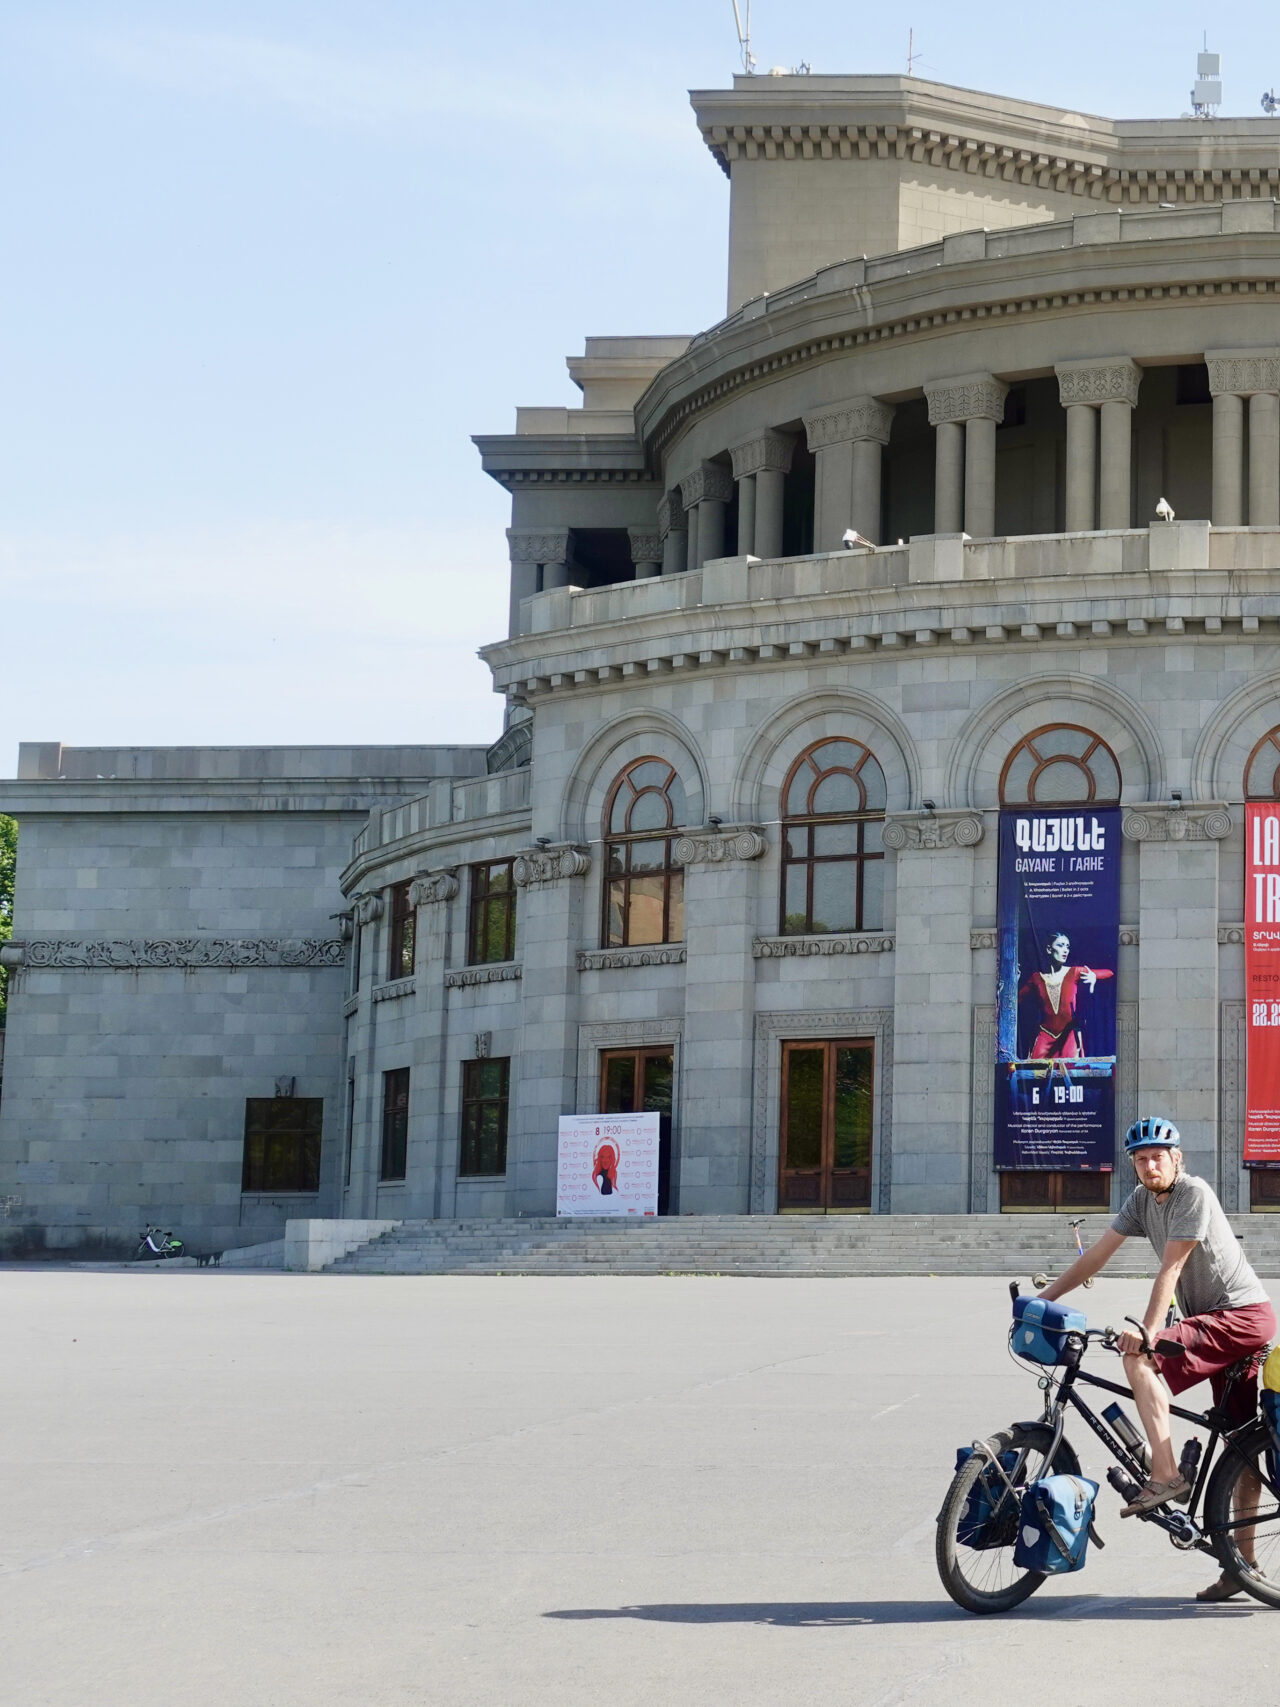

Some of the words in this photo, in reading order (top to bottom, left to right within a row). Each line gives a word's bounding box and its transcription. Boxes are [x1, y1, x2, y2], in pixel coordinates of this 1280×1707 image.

[1016, 817, 1105, 852] ԳԱՅԱՆԵ
[1253, 816, 1279, 866] LA
[1015, 858, 1056, 872] GAYANE
[1070, 856, 1104, 871] ГАЯНЕ
[1032, 1087, 1040, 1104] 6
[1054, 1085, 1083, 1103] 19:00
[595, 1127, 600, 1135] 8
[1090, 1416, 1143, 1481] RENNSTH
